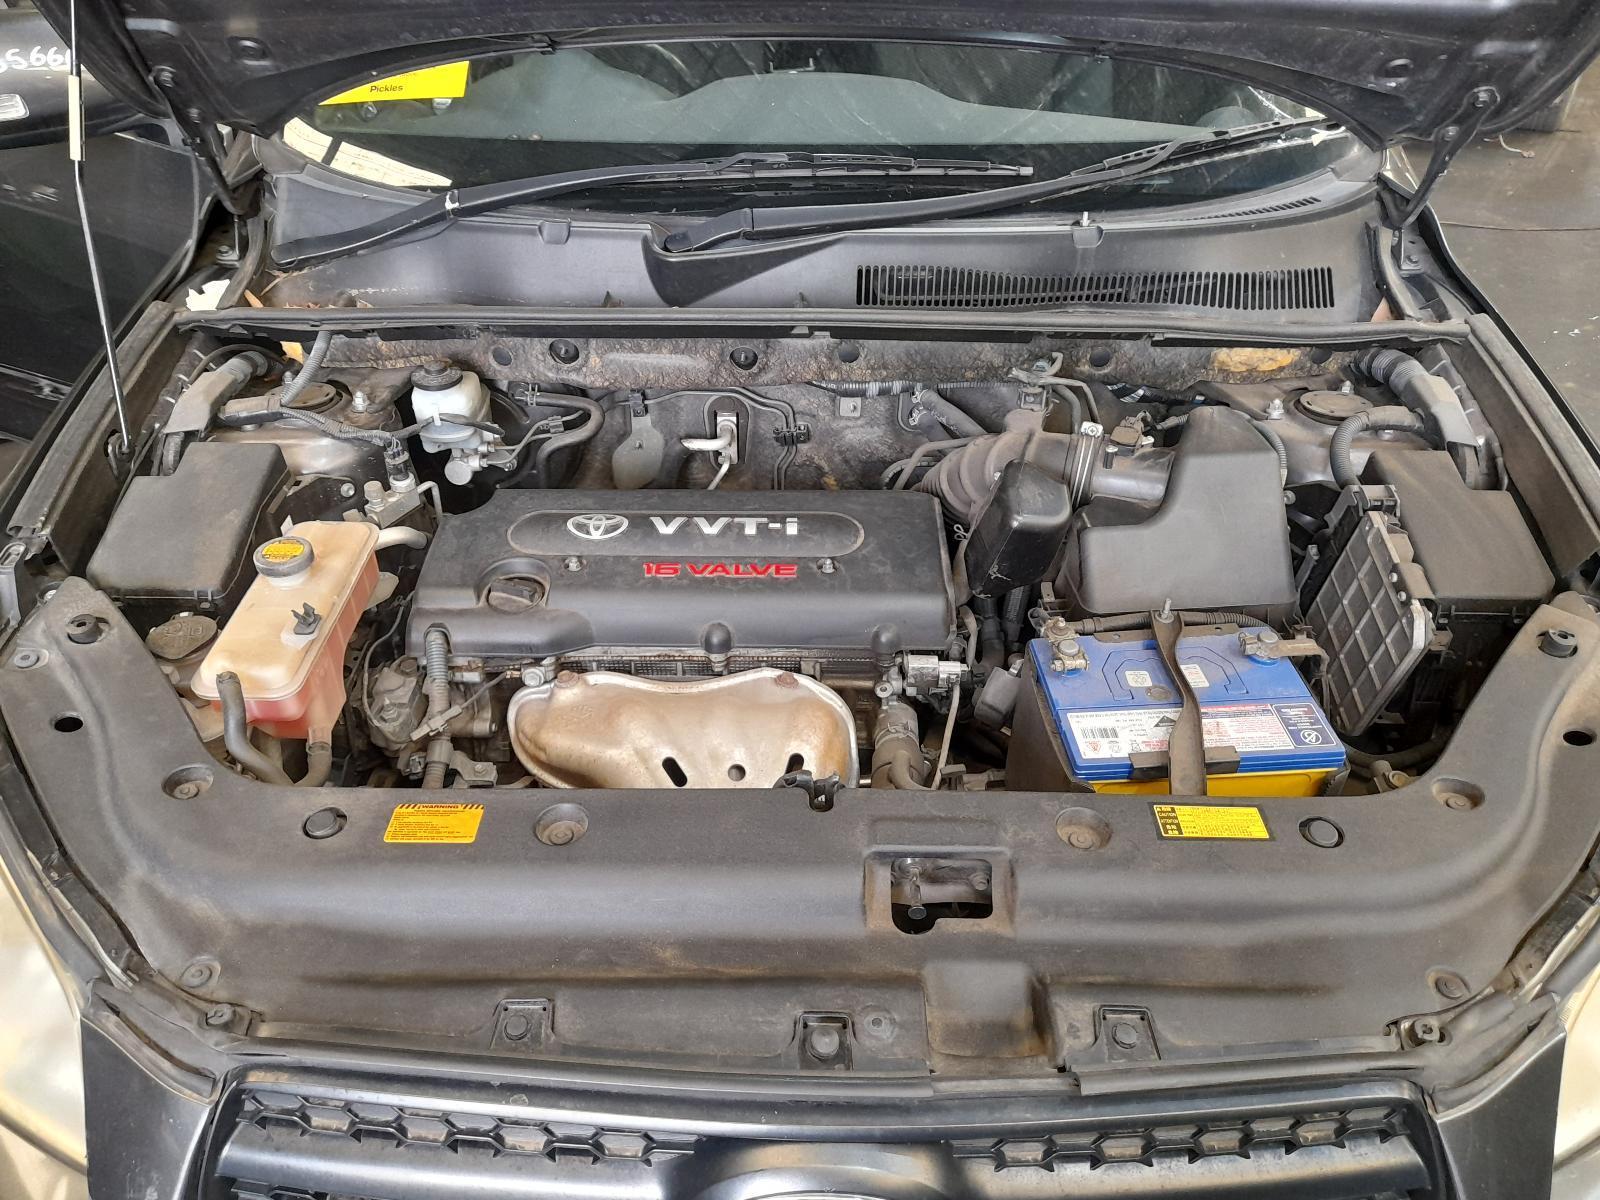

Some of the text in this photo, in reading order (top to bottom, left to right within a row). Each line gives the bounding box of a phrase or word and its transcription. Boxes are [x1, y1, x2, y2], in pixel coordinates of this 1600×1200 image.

[370, 84, 404, 93] Pickles
[650, 516, 798, 535] VVT-i
[643, 562, 798, 577] 16 VALVE
